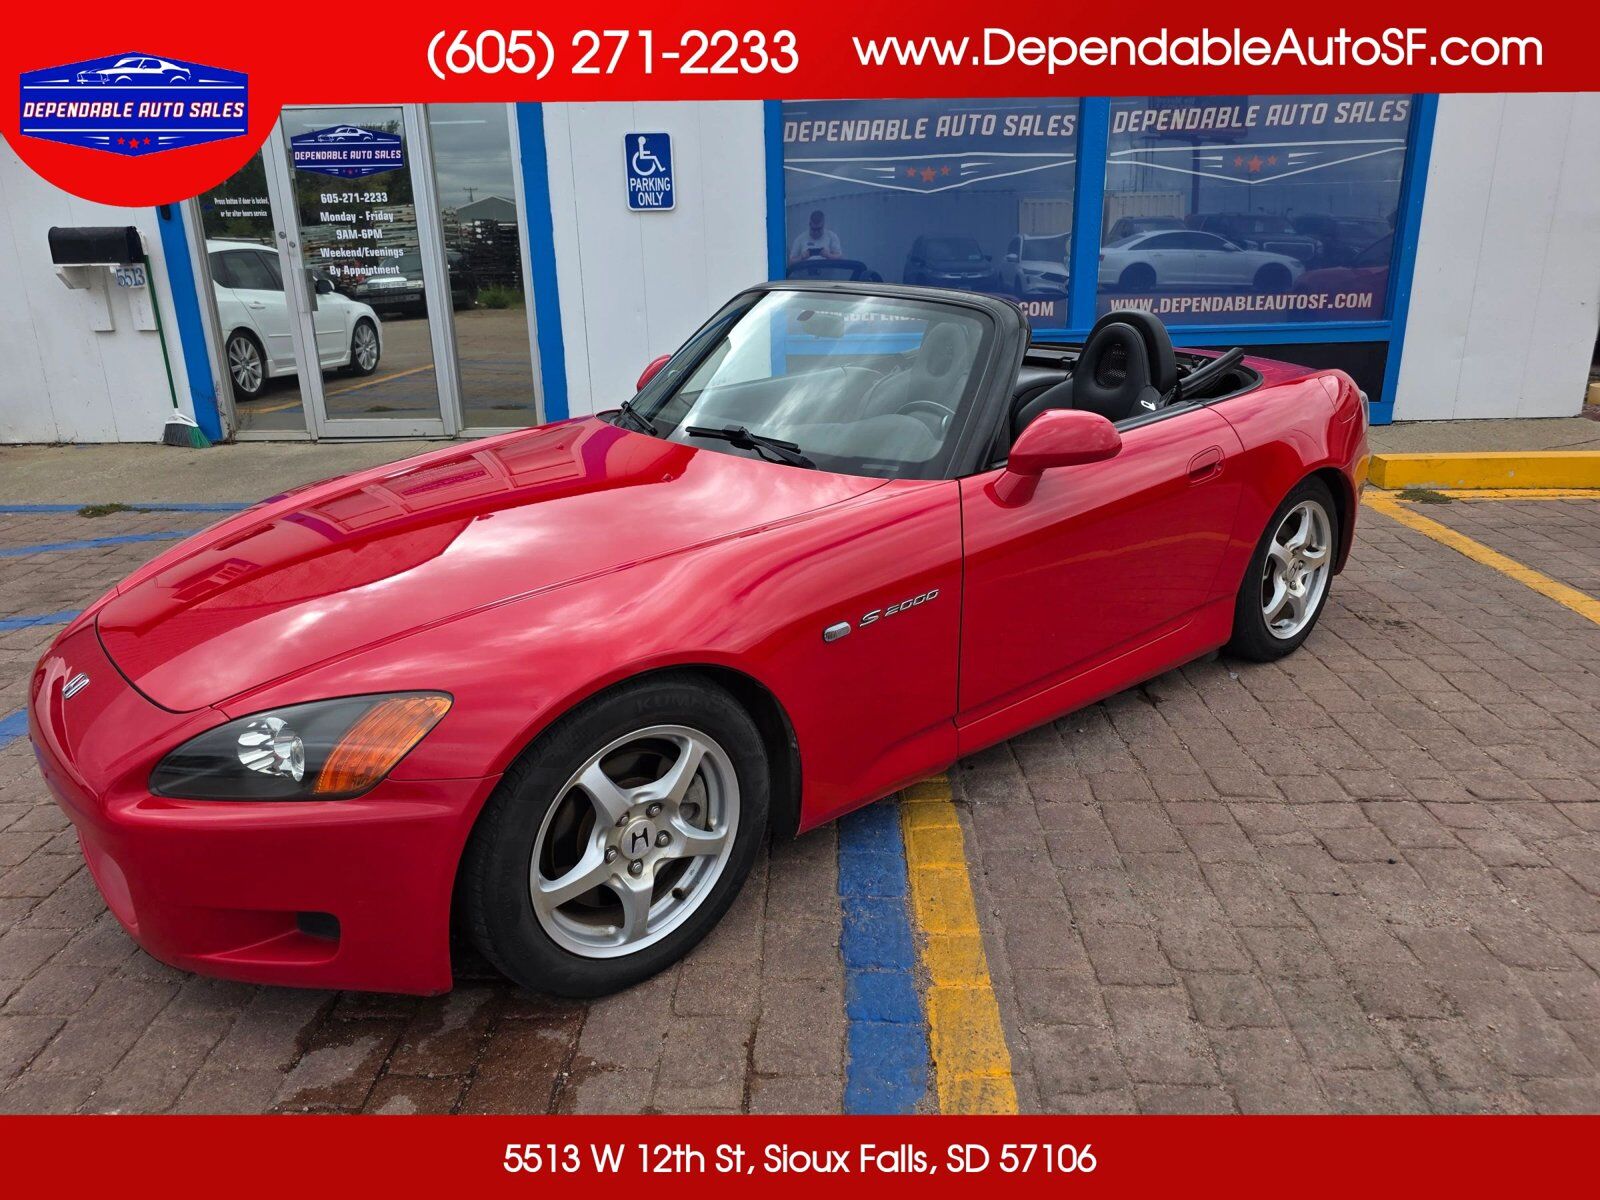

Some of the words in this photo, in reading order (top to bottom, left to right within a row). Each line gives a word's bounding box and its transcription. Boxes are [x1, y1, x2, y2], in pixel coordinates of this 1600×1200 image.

[1112, 105, 1260, 134] DEPENDABLE
[1265, 102, 1329, 127] AUTO
[1334, 100, 1410, 124] SALES
[783, 117, 930, 142] DEPENDABLE
[935, 114, 998, 138] AUTO
[1003, 114, 1077, 137] SALES
[294, 151, 348, 160] DEPENDABLE
[350, 150, 373, 160] AUTO
[374, 150, 402, 159] SALES
[629, 177, 671, 192] PARKING
[214, 197, 225, 205] Press
[320, 192, 388, 204] 605-271-2233
[638, 192, 664, 206] ONLY
[320, 211, 356, 223] Monday
[365, 210, 394, 222] Friday
[336, 228, 383, 239] 9AM-6PM
[320, 246, 404, 258] Weekend/Evenings
[116, 267, 146, 287] 5513
[329, 265, 341, 277] By
[343, 265, 400, 277] Appointment
[1111, 293, 1372, 313] WWW.DEPENDABLEAUTOSF.COM
[859, 609, 882, 628] S
[884, 588, 940, 617] 2000
